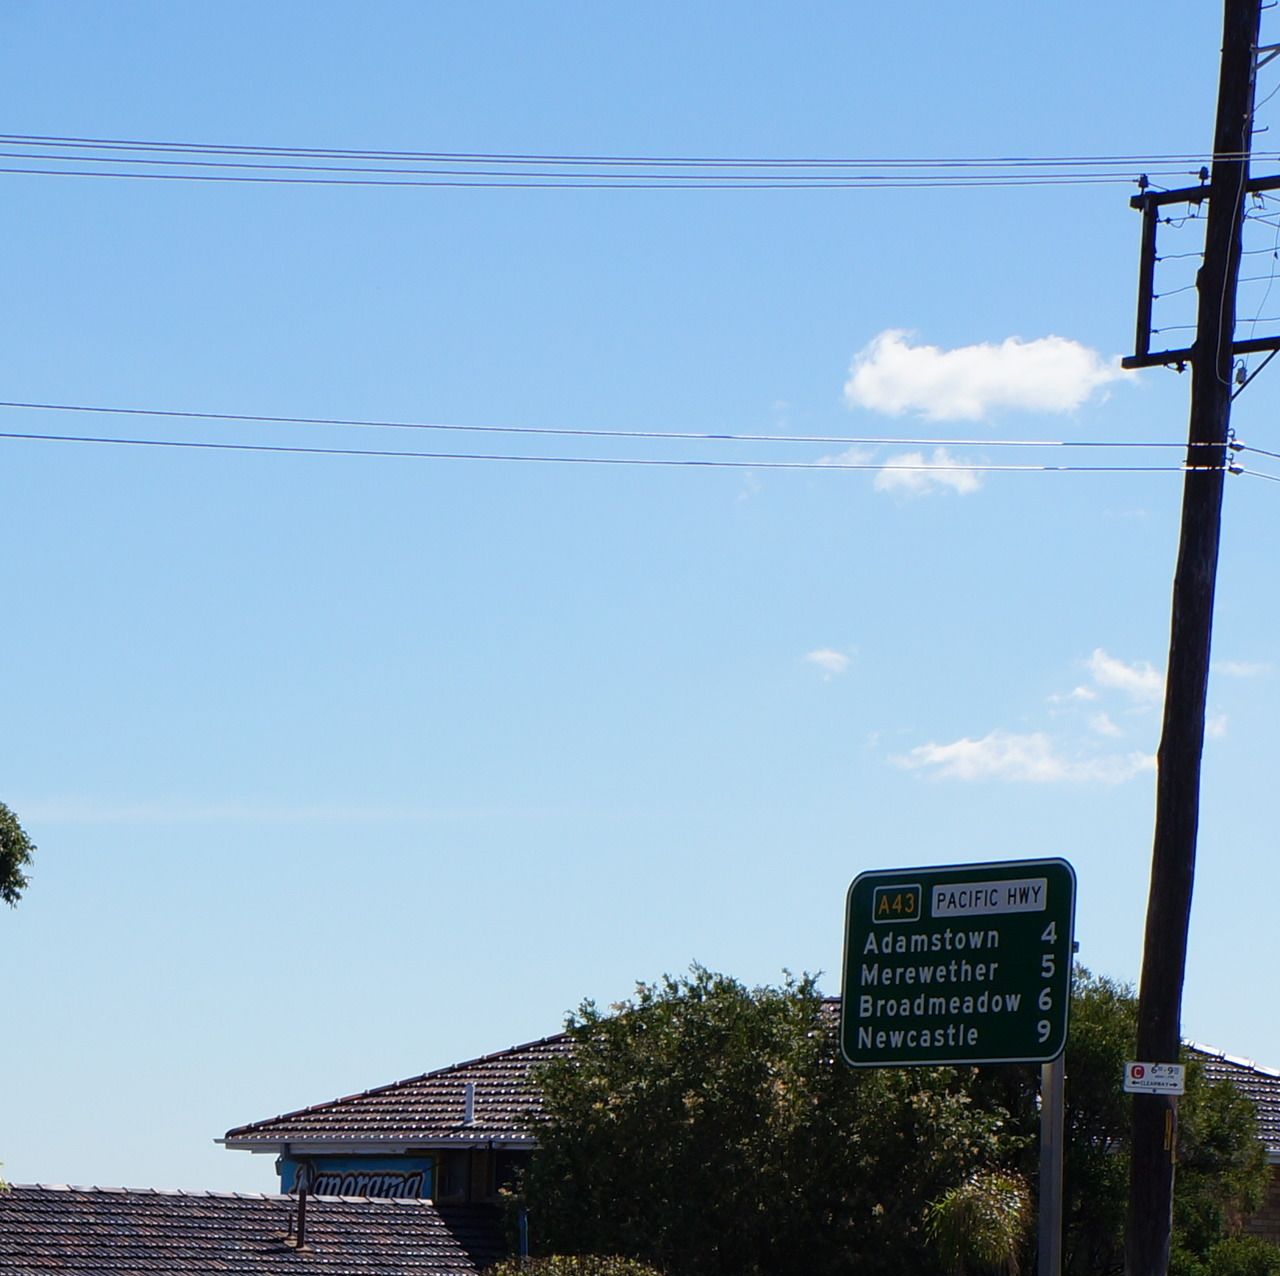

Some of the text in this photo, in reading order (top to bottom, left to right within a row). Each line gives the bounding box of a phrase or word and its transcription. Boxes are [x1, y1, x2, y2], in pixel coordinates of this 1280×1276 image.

[878, 892, 915, 915] A43
[936, 885, 1042, 910] PACIFIC HWY
[864, 921, 1057, 954] Adamstown 4
[861, 954, 1055, 986] Merewether 5
[859, 987, 1053, 1018] Broadmeadow 6
[858, 1019, 1051, 1049] Newcastle 9
